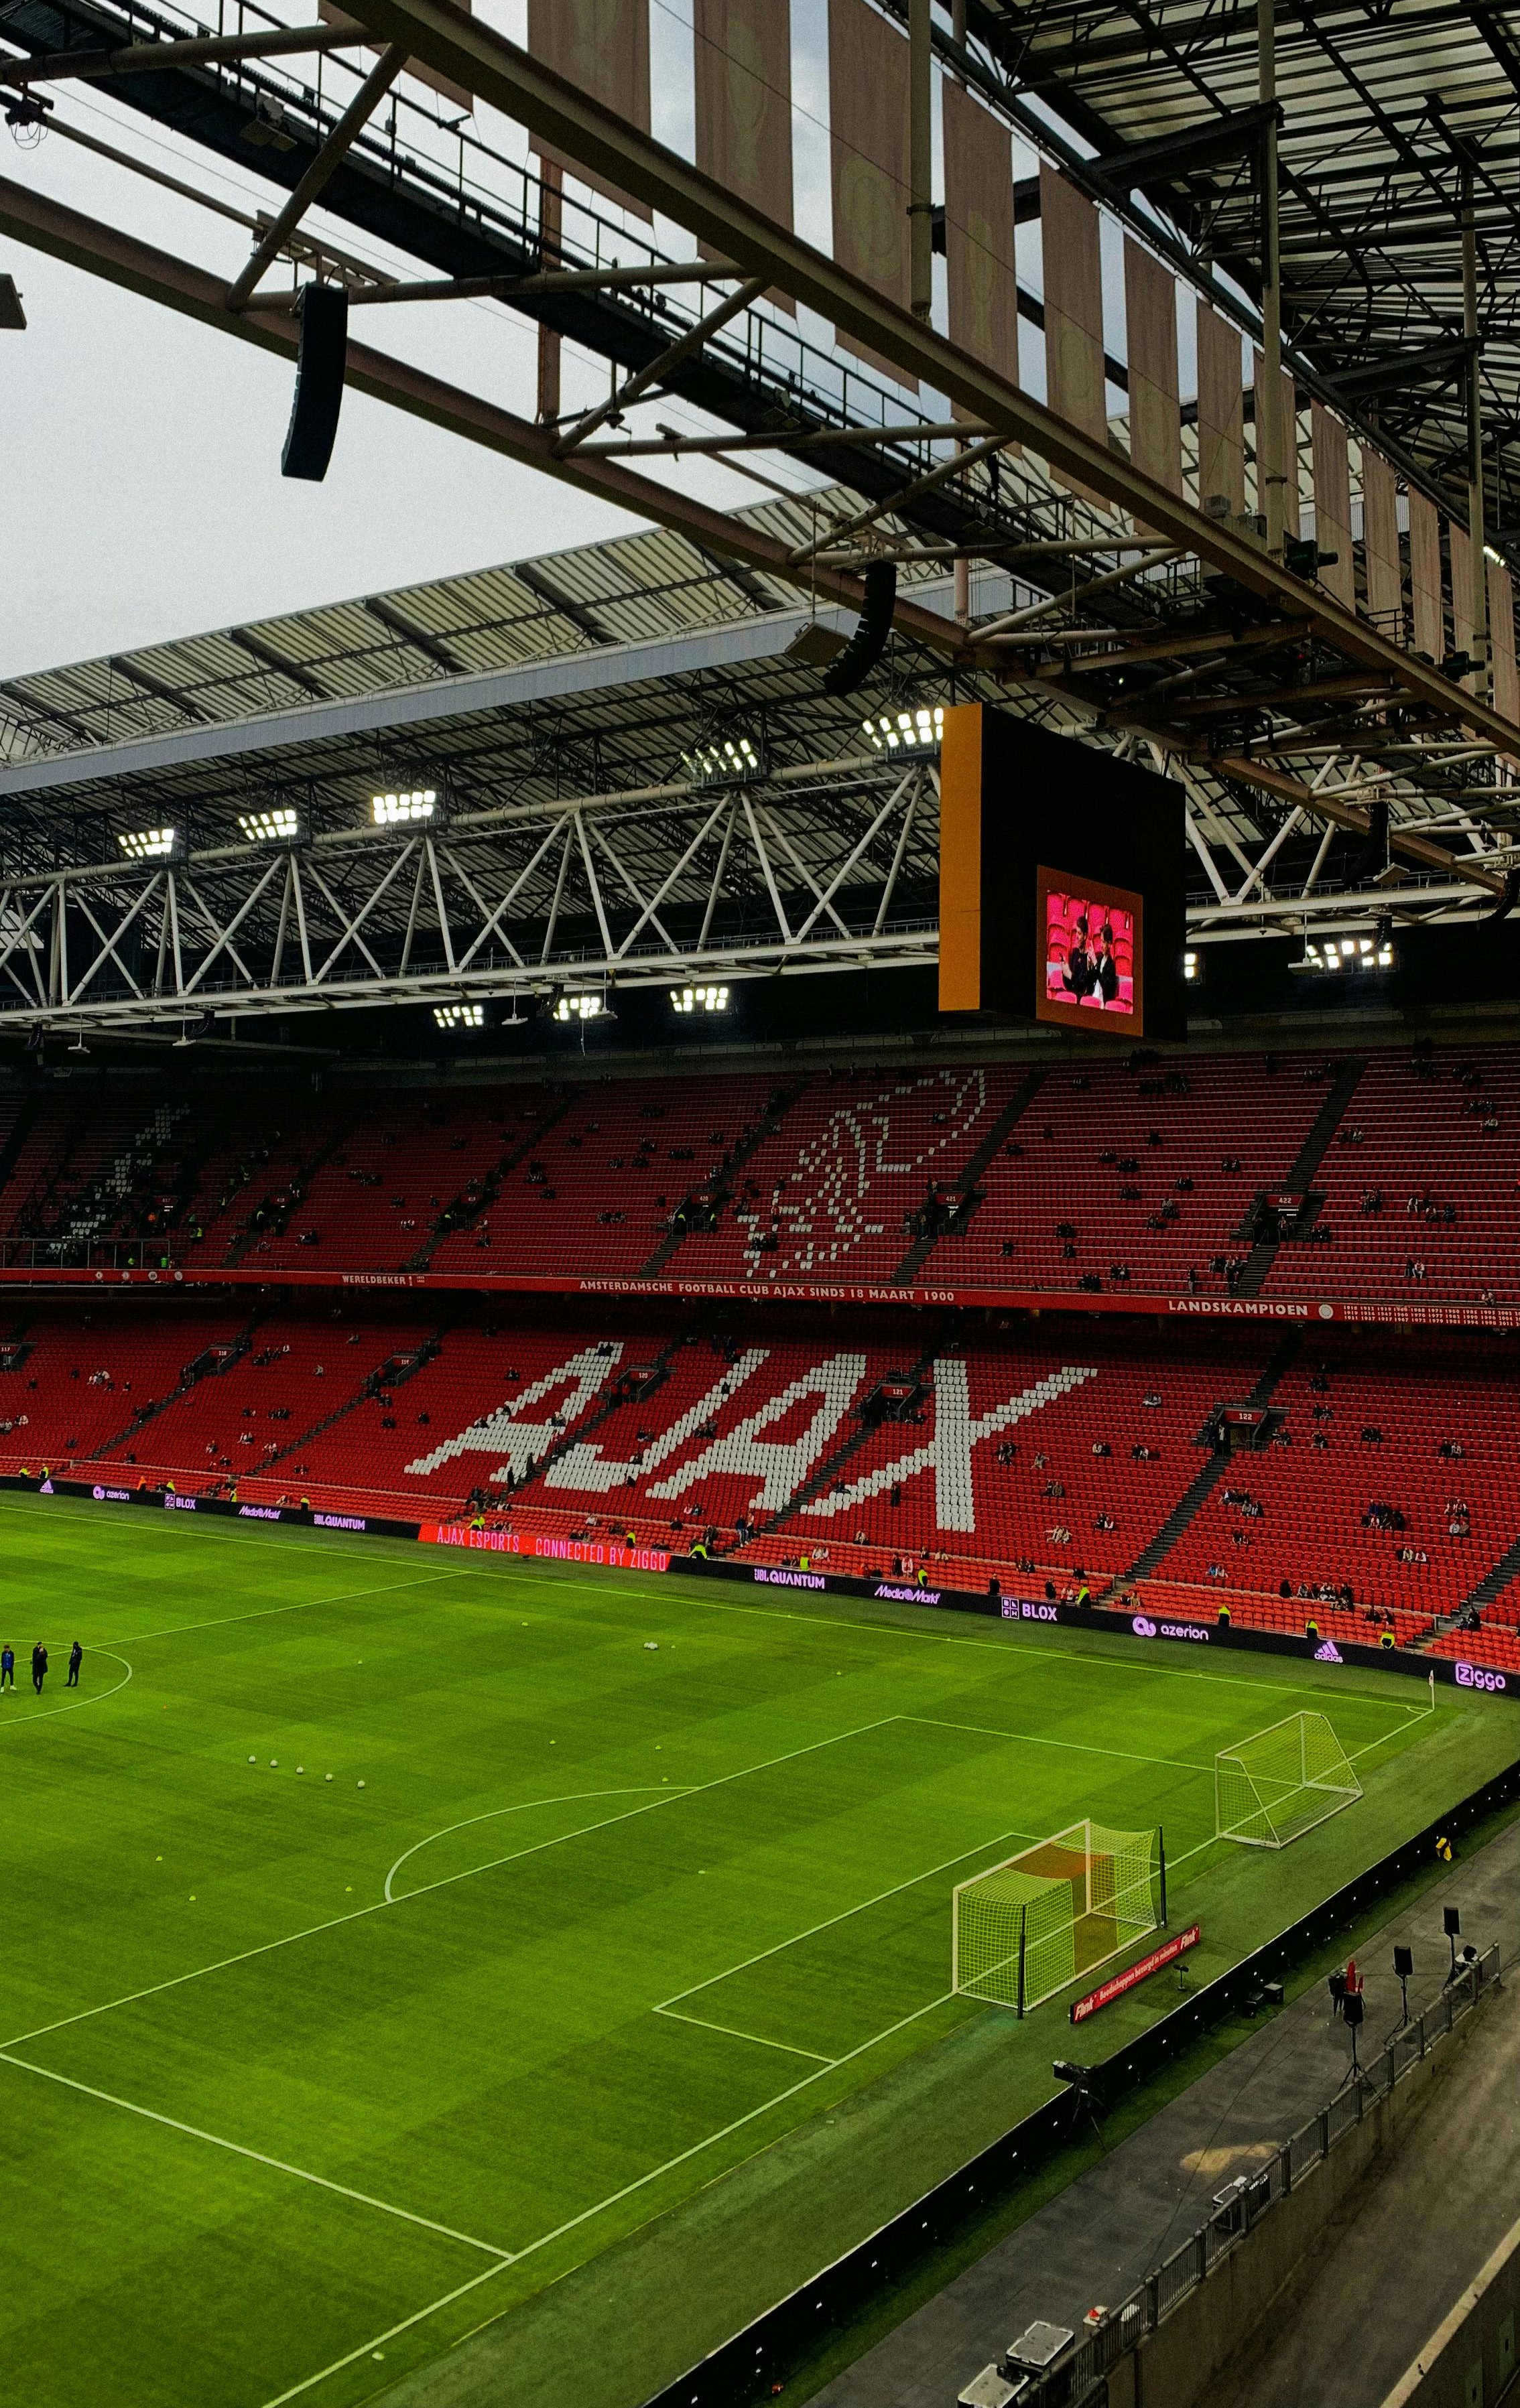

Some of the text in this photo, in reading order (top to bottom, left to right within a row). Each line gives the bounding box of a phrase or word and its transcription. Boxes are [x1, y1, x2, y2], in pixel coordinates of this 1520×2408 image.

[342, 1275, 406, 1284] WERELDBEKER
[580, 1280, 954, 1302] AMSTERDAMSCHE FOOTBALL CLUB AJAX SINDS 18 MAART 1900
[1168, 1300, 1308, 1316] LANDSKAMPIOEN
[1239, 1412, 1253, 1420] 122
[404, 1342, 1098, 1532] AJAX
[176, 1497, 196, 1510] BLOX
[325, 1515, 365, 1530] QUANTUM
[437, 1526, 465, 1546] AJAX
[470, 1530, 519, 1553] ESPORTS
[536, 1538, 604, 1563] CONNECTED
[610, 1546, 624, 1566] BY
[630, 1549, 666, 1572] ZIGGO
[769, 1570, 825, 1589] QUANTUM
[1022, 1603, 1058, 1621] BLOX
[1161, 1625, 1209, 1641] azerion
[1314, 1653, 1343, 1663] adidas
